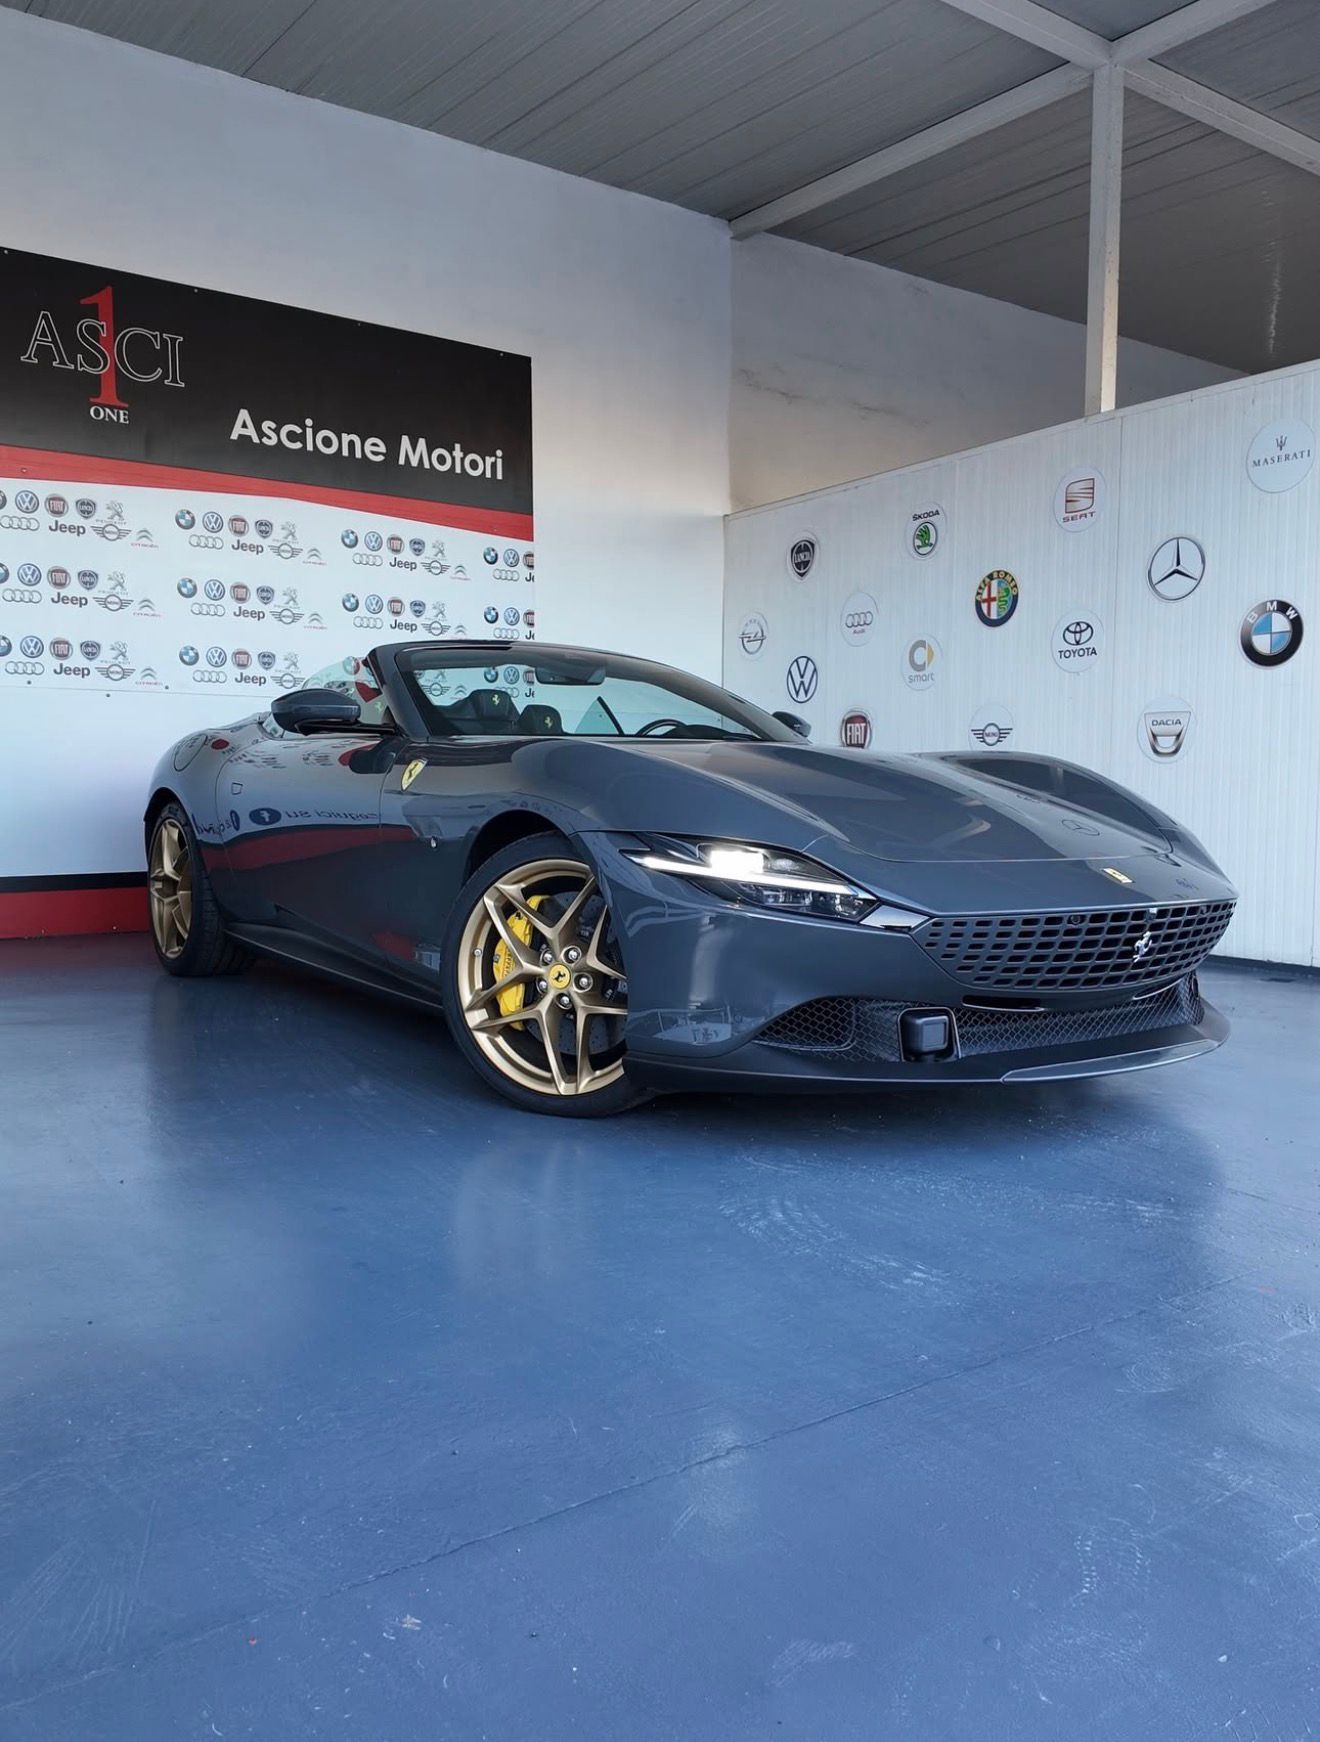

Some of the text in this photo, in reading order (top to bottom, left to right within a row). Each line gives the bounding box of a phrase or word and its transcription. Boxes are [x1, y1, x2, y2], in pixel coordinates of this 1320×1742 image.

[89, 405, 129, 424] ONE
[229, 408, 504, 480] Ascione Motori
[1252, 449, 1312, 468] MASERATI
[1062, 511, 1097, 523] SEAT
[49, 520, 86, 536] Jeep
[231, 539, 264, 555] Jeep
[389, 556, 417, 571] Jeep
[50, 592, 88, 608] Jeep
[233, 606, 265, 621] Jeep
[390, 618, 418, 633] Jeep
[1058, 647, 1098, 660] TOYOTA
[53, 663, 90, 679] Jeep
[908, 672, 935, 683] smart
[235, 672, 267, 686] Jeep
[1151, 718, 1182, 727] DACIA
[847, 723, 867, 745] FIAT
